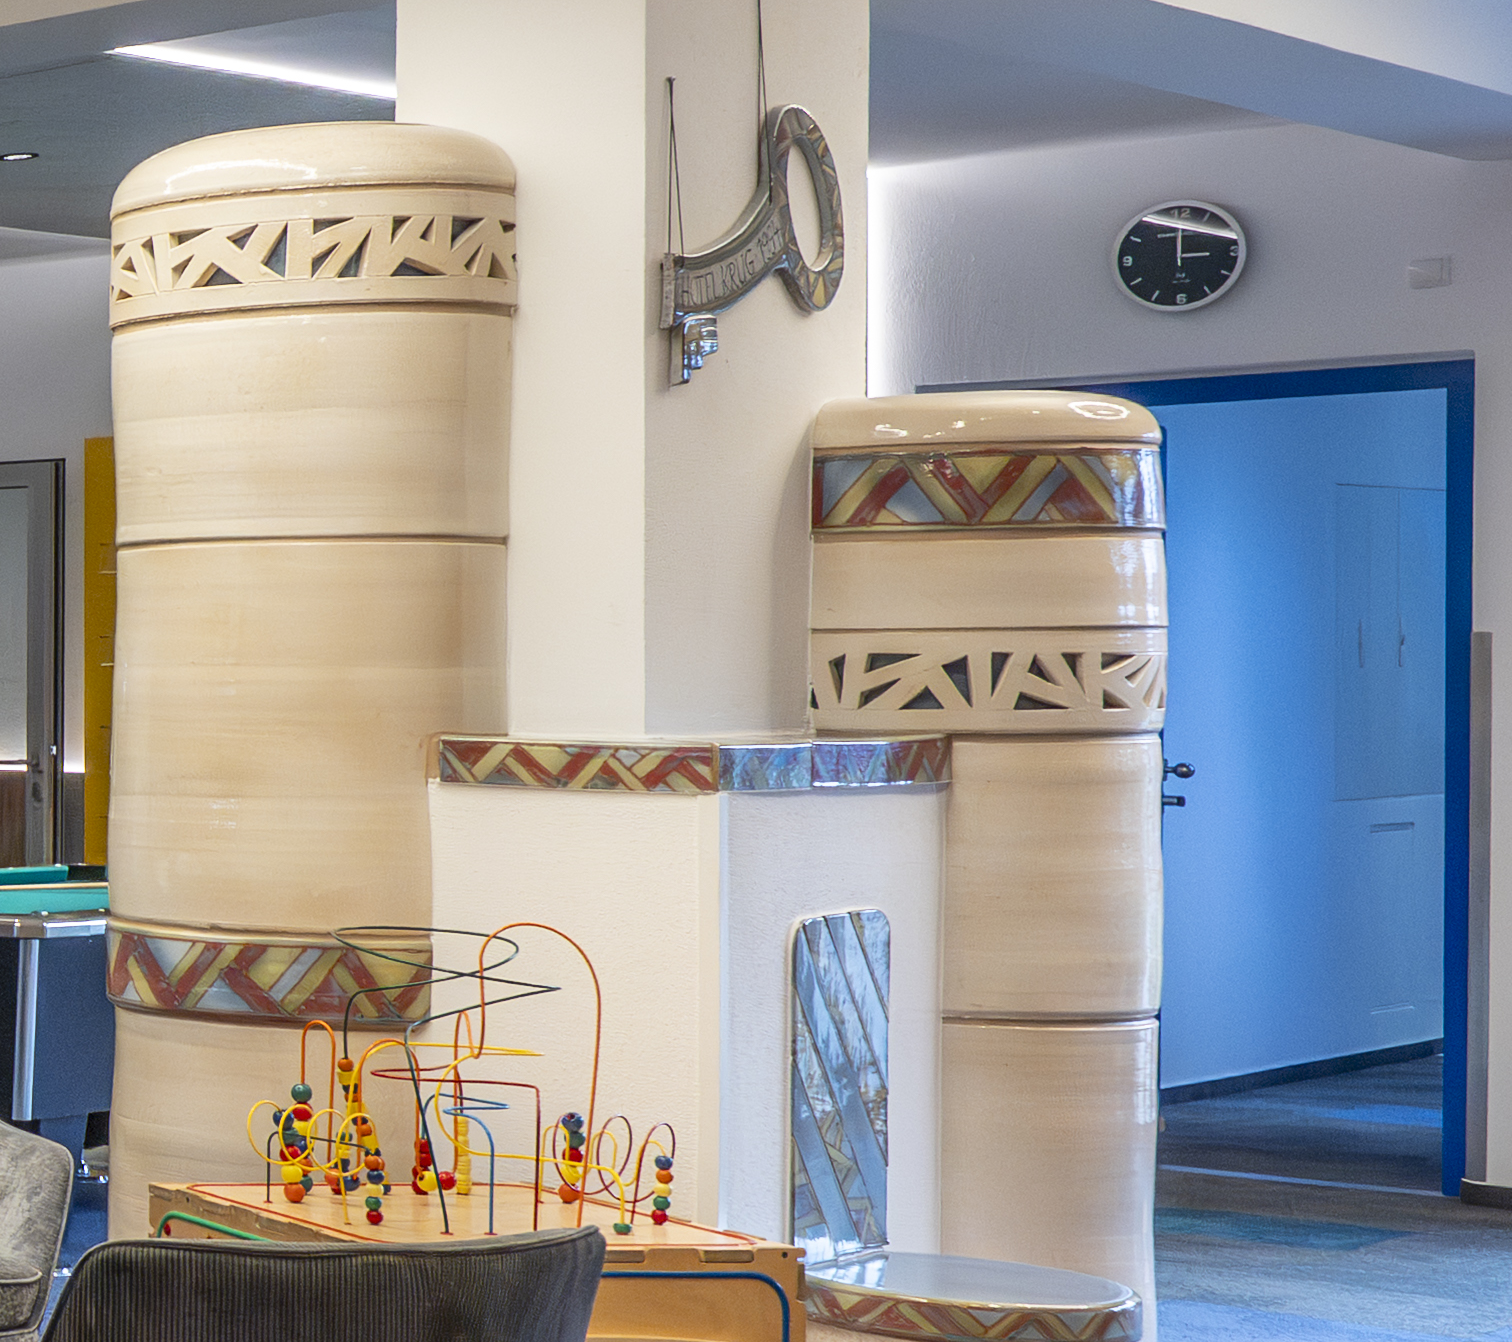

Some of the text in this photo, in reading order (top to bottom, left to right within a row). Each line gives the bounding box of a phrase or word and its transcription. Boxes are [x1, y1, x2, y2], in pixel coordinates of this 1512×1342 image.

[1171, 208, 1190, 219] 12
[1230, 245, 1239, 256] 3
[1123, 256, 1133, 267] 9
[680, 269, 723, 308] HOTEL
[720, 248, 755, 297] KRUG
[1176, 294, 1186, 304] 6
